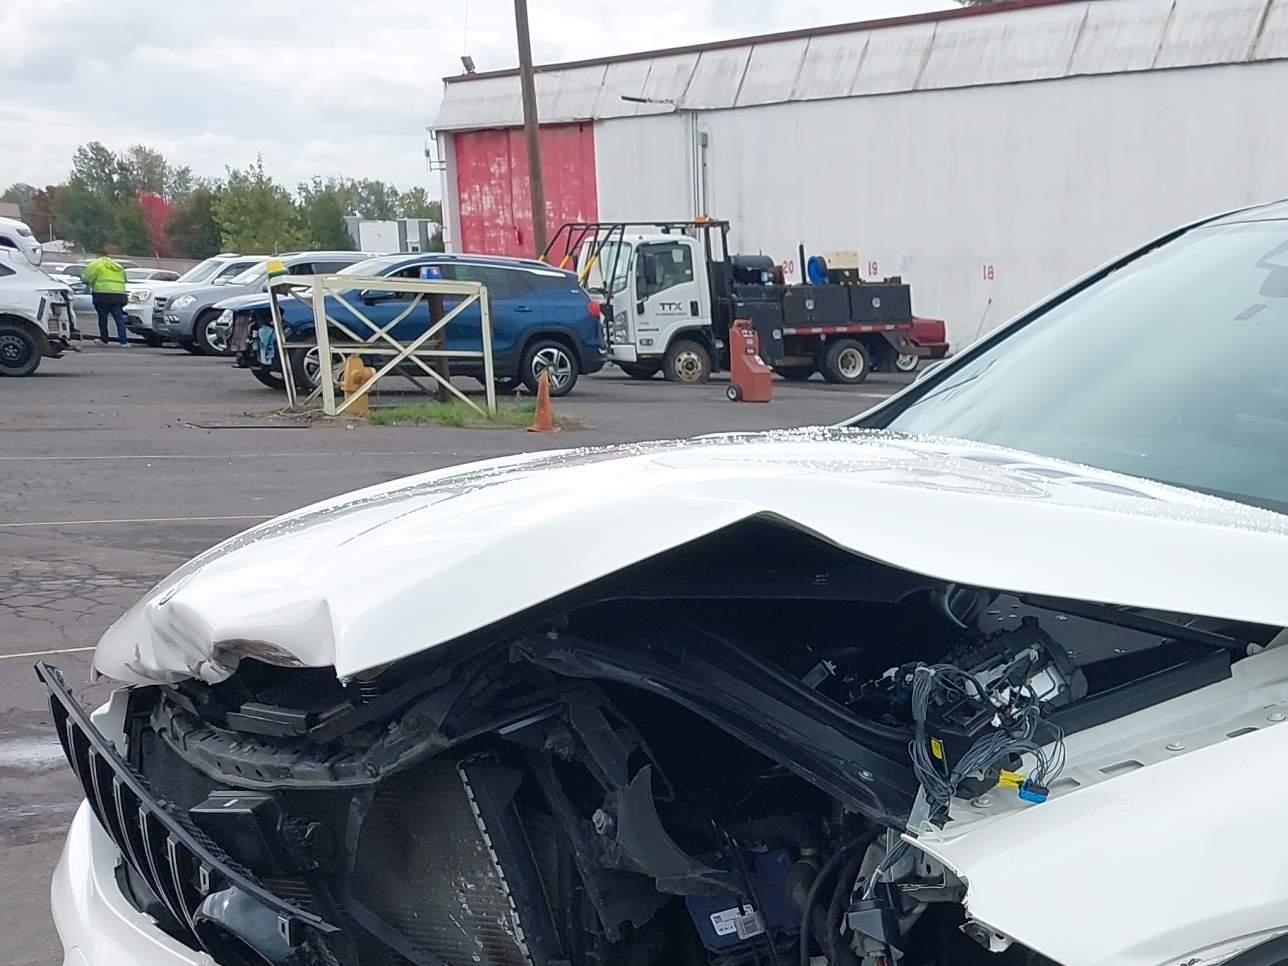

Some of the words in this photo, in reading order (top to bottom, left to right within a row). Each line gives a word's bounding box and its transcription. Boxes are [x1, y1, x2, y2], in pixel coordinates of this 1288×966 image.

[782, 260, 794, 275] 20
[983, 265, 994, 280] 18
[659, 302, 682, 311] TTX
